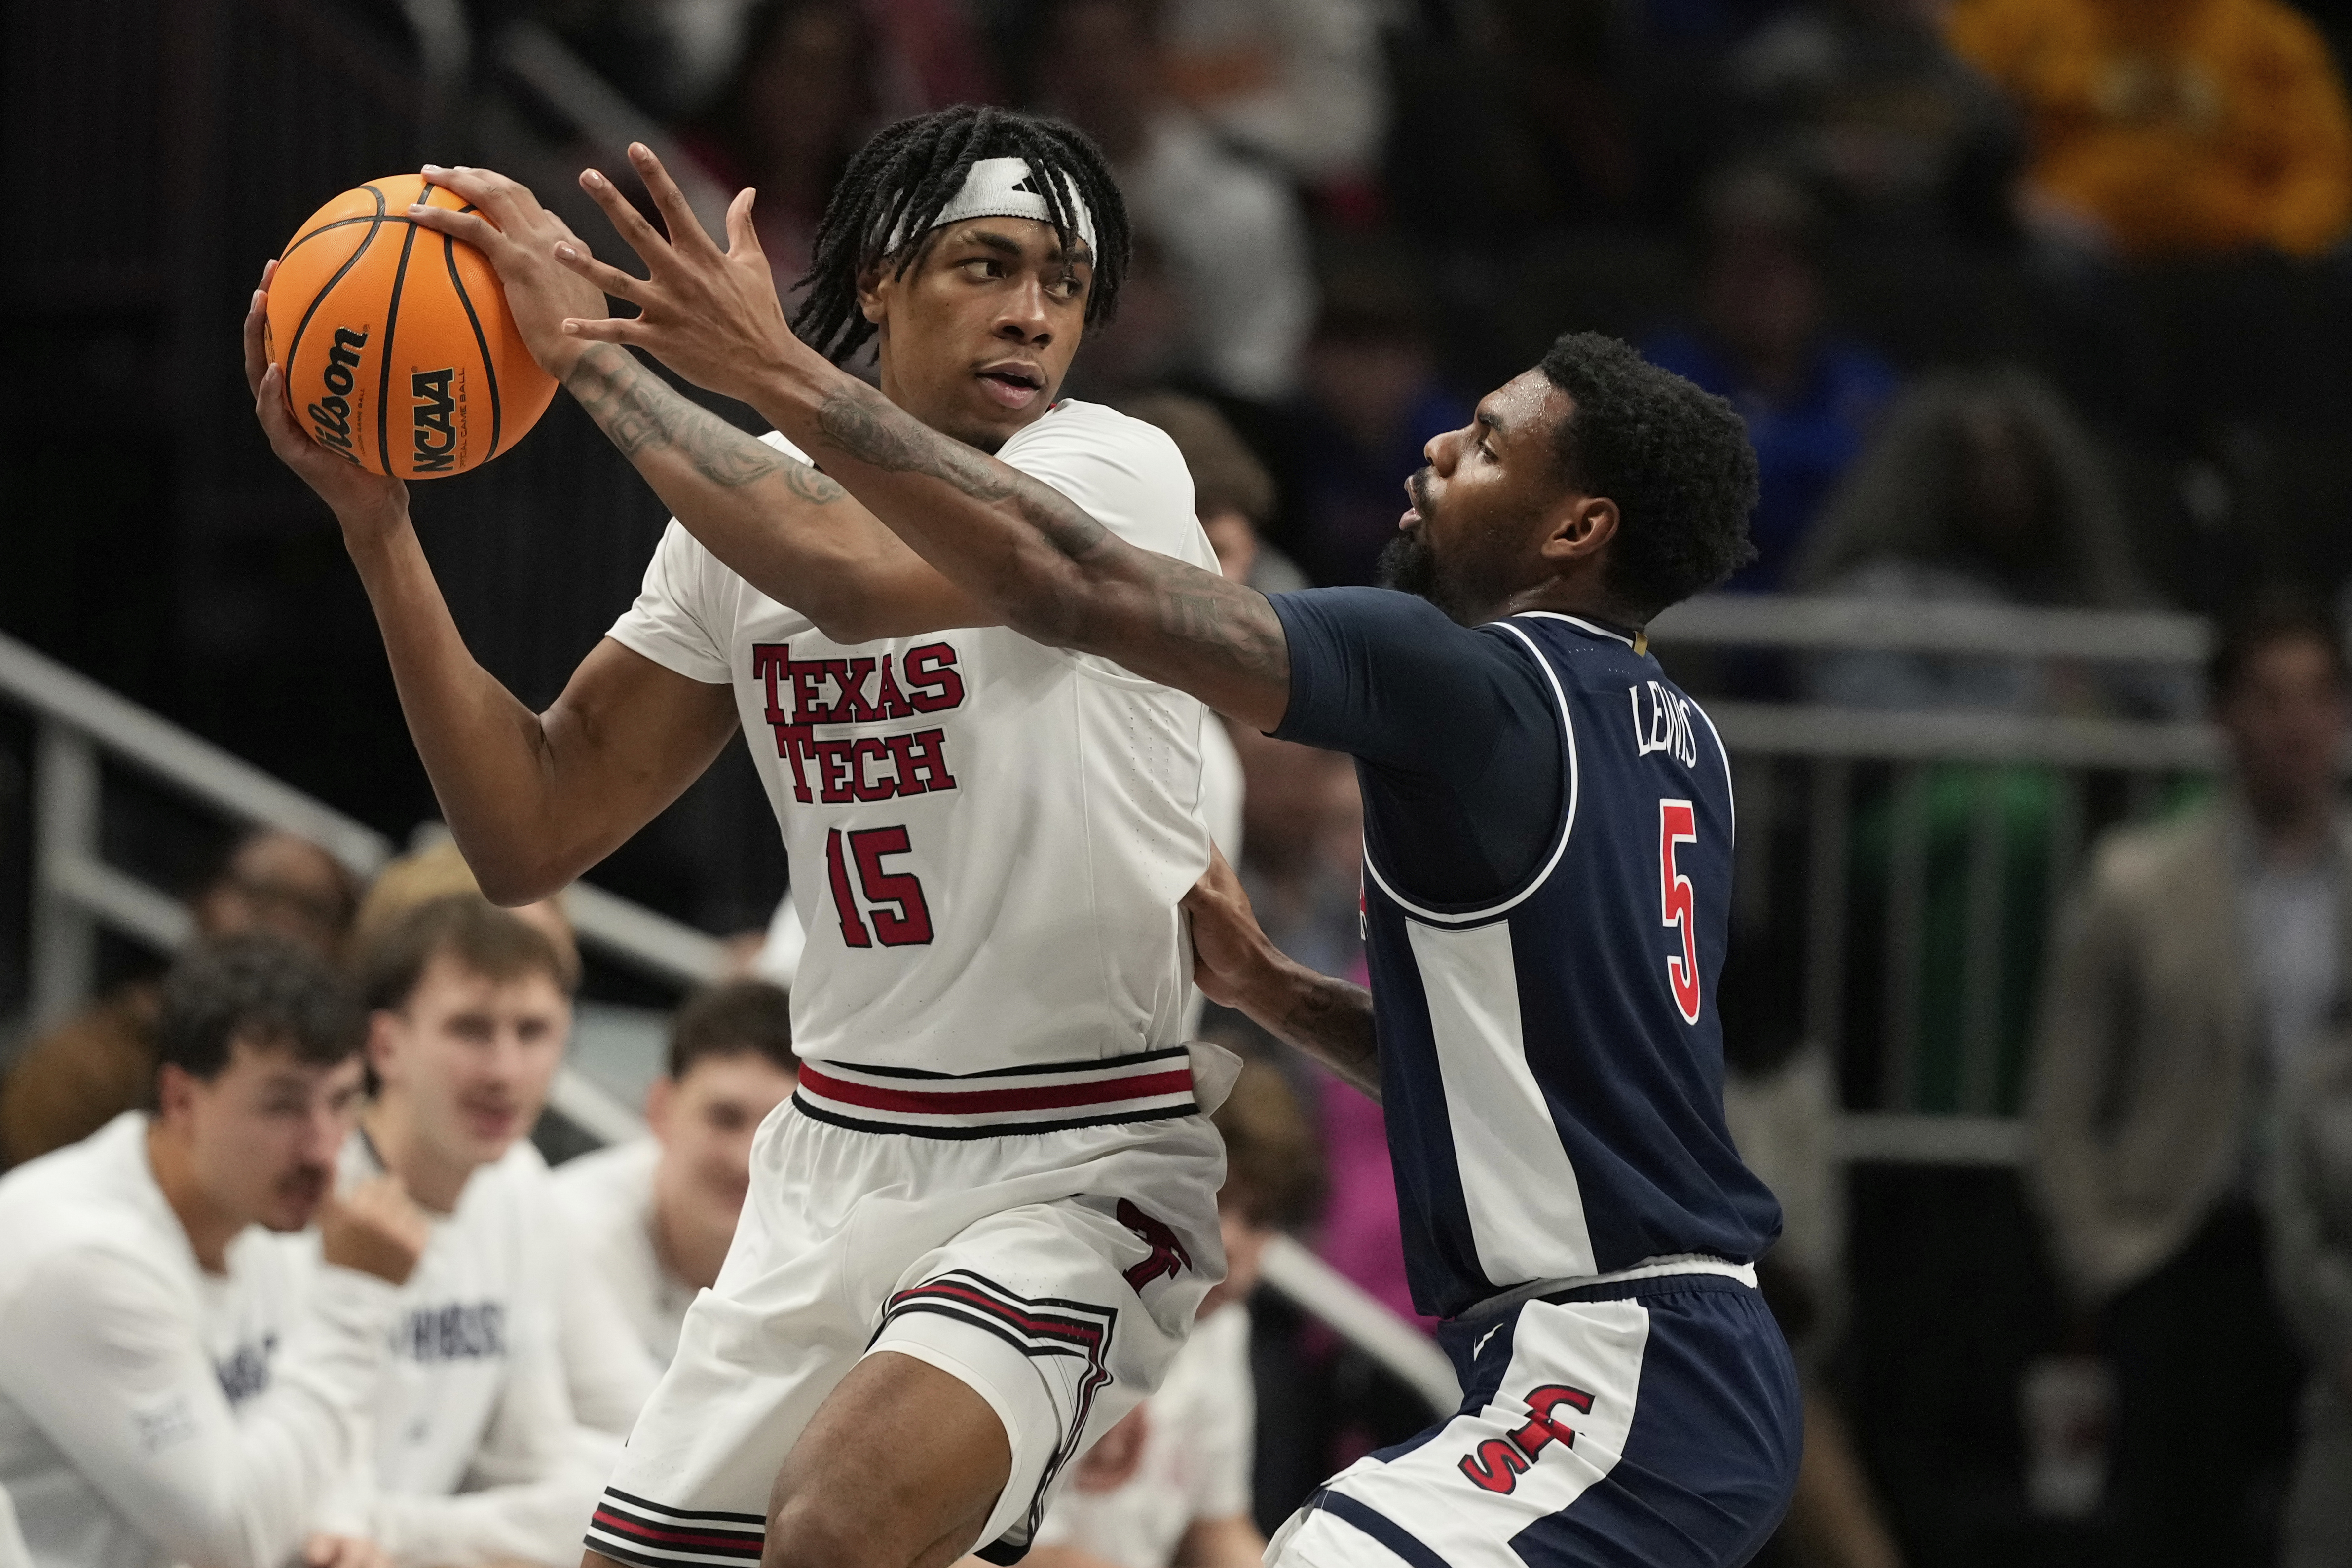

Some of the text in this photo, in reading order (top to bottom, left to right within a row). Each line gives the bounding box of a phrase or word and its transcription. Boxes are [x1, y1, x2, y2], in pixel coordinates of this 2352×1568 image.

[411, 367, 456, 472] NCAA
[459, 405, 468, 438] GAME
[752, 641, 965, 725] TEXAS
[1629, 681, 1696, 769] LEWIS
[774, 724, 957, 804] TECH
[826, 824, 934, 948] 15
[1659, 798, 1700, 1025] 5
